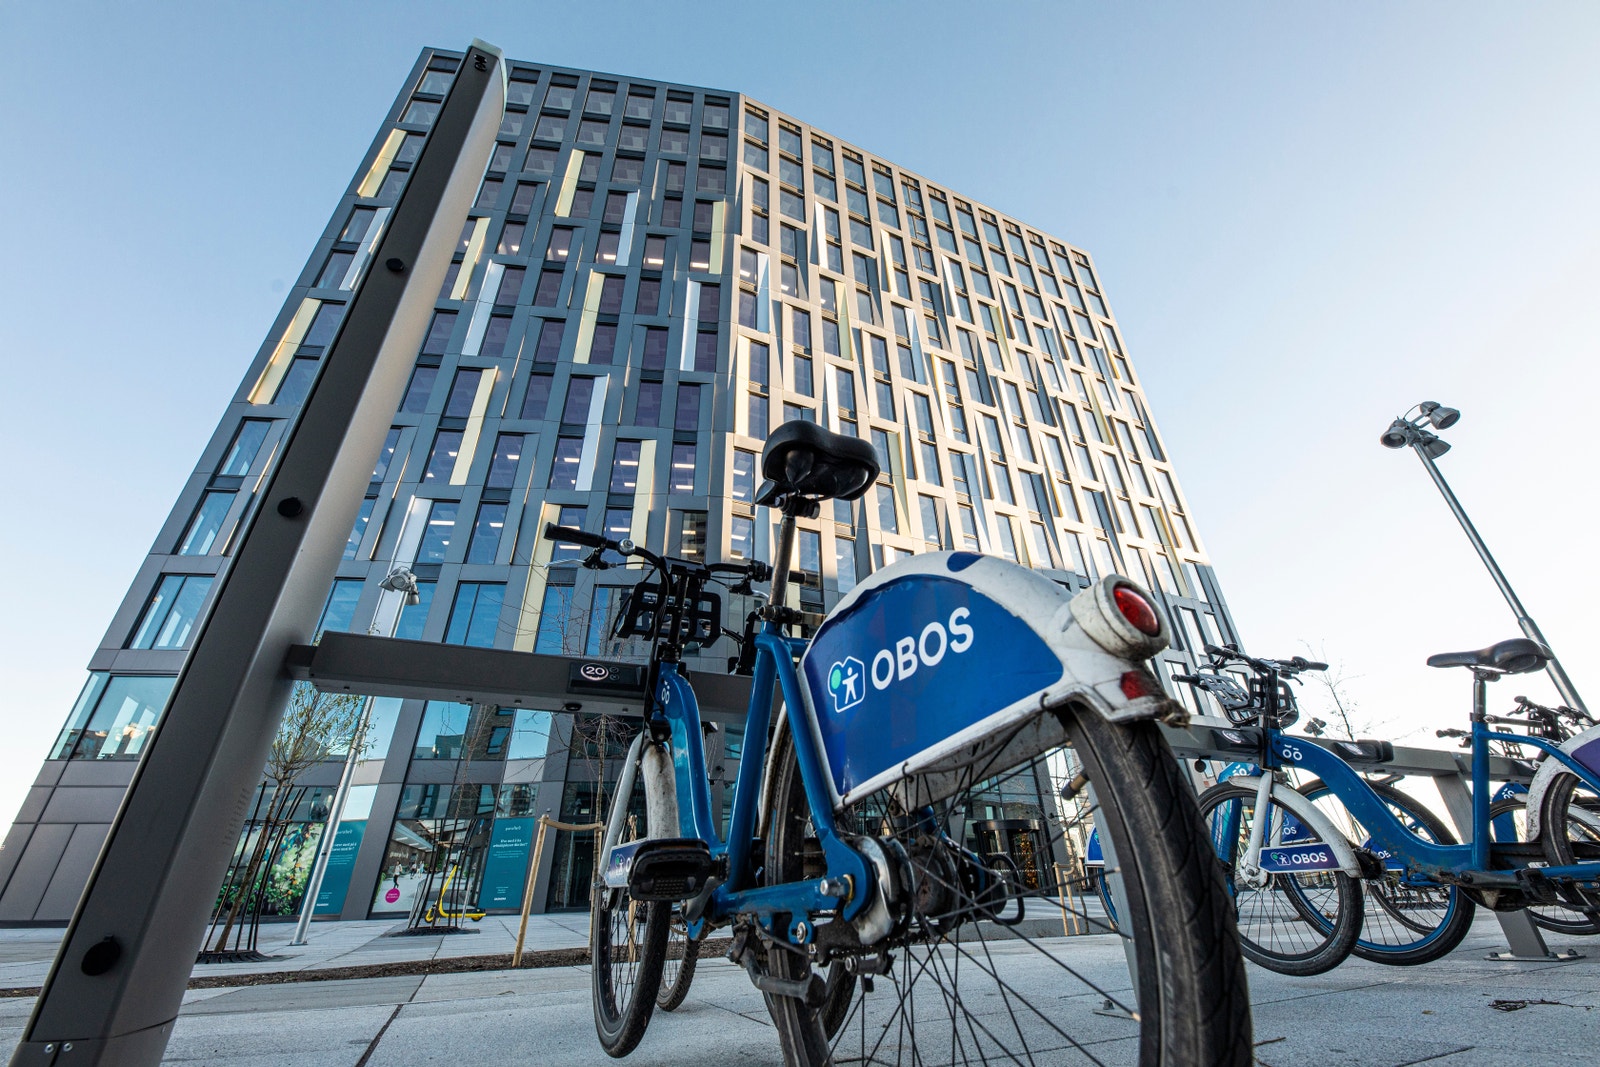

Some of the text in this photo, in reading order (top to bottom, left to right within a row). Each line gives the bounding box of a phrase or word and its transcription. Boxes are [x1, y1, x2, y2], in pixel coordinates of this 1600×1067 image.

[871, 606, 974, 690] OBOS
[585, 666, 605, 676] 20
[1282, 826, 1297, 835] OS
[1291, 852, 1328, 865] OBOS
